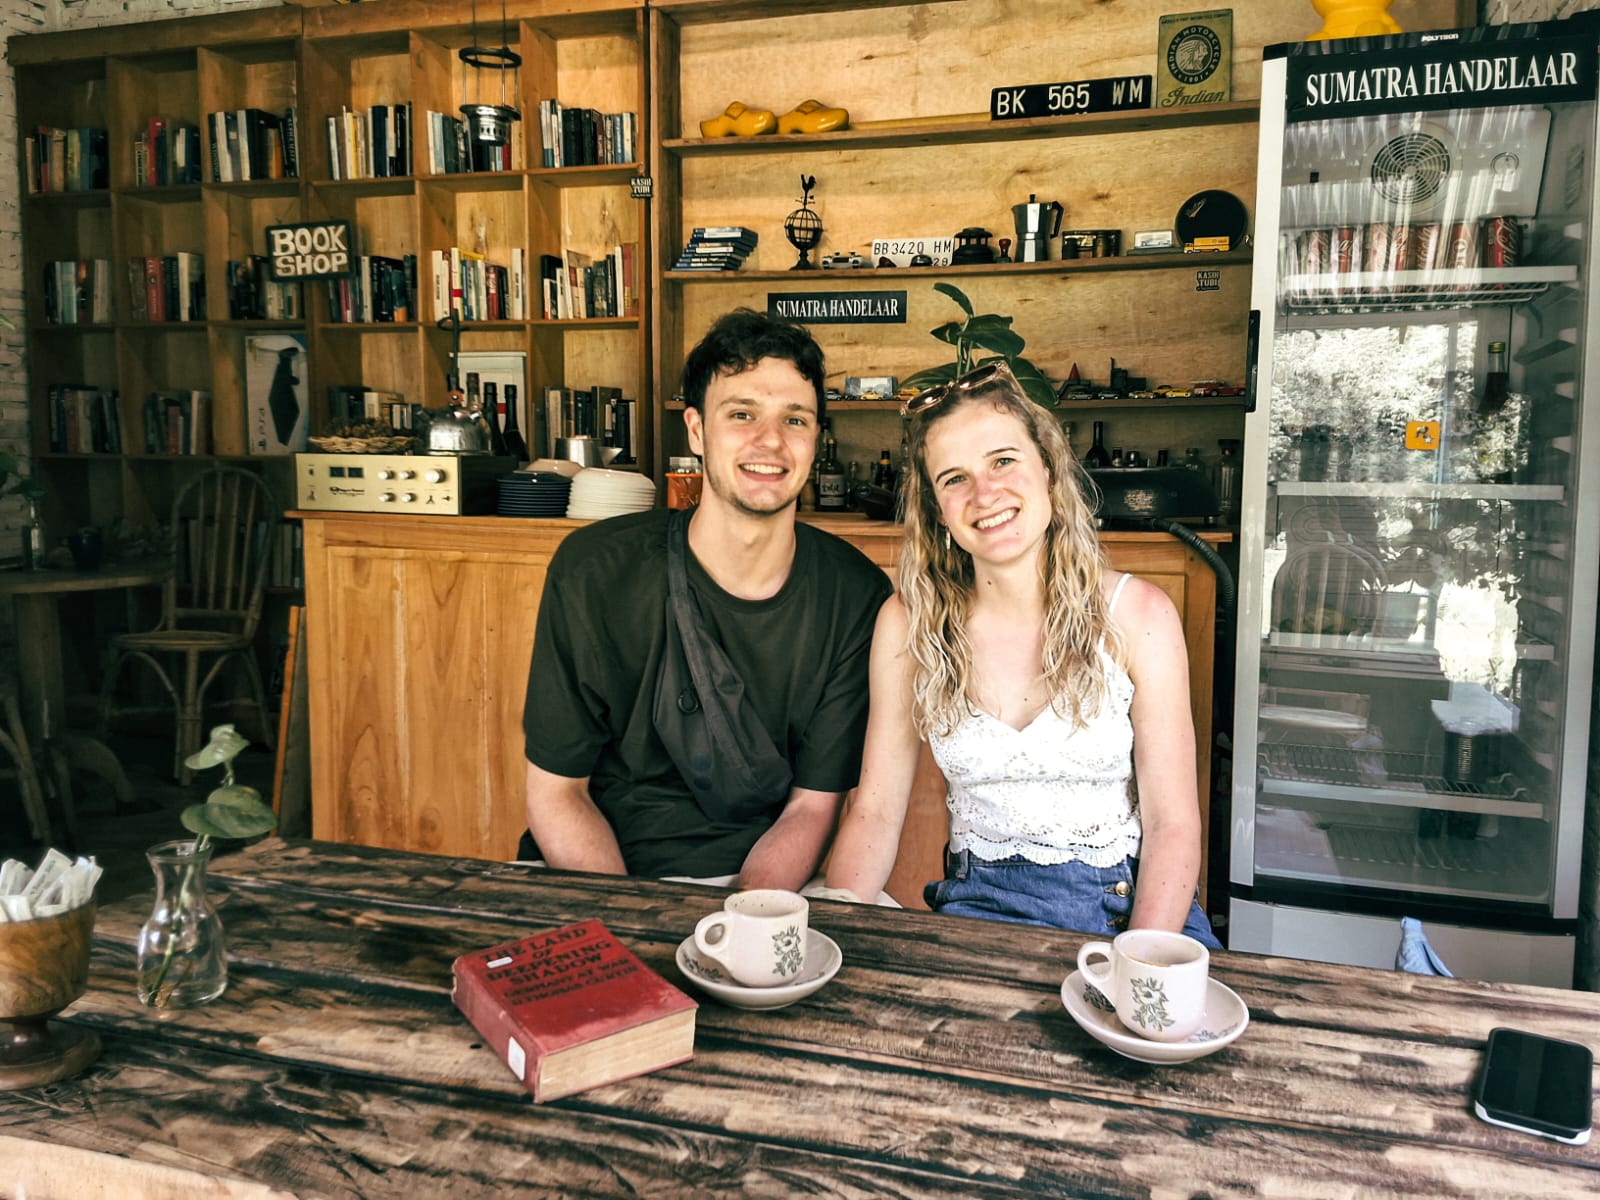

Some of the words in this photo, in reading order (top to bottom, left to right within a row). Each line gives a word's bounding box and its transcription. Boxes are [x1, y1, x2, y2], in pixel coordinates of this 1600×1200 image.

[1183, 26, 1220, 71] MOTORCYCLE
[1306, 66, 1420, 107] SUMATRA
[1423, 52, 1578, 96] HANDELAAR
[997, 89, 1026, 116] BK
[1048, 83, 1091, 111] 565
[1112, 78, 1144, 105] WM
[1161, 86, 1225, 107] Indian
[270, 225, 348, 256] BOOK
[874, 242, 889, 255] BB
[891, 242, 924, 254] 3420
[933, 240, 951, 253] HM
[275, 252, 348, 277] SHOP
[776, 300, 828, 318] SUMATRA
[830, 298, 898, 317] HANDELAAR
[530, 928, 588, 950] LAND
[487, 940, 612, 981] DEEPENING
[532, 948, 553, 959] OF
[510, 953, 602, 985] SHADOW
